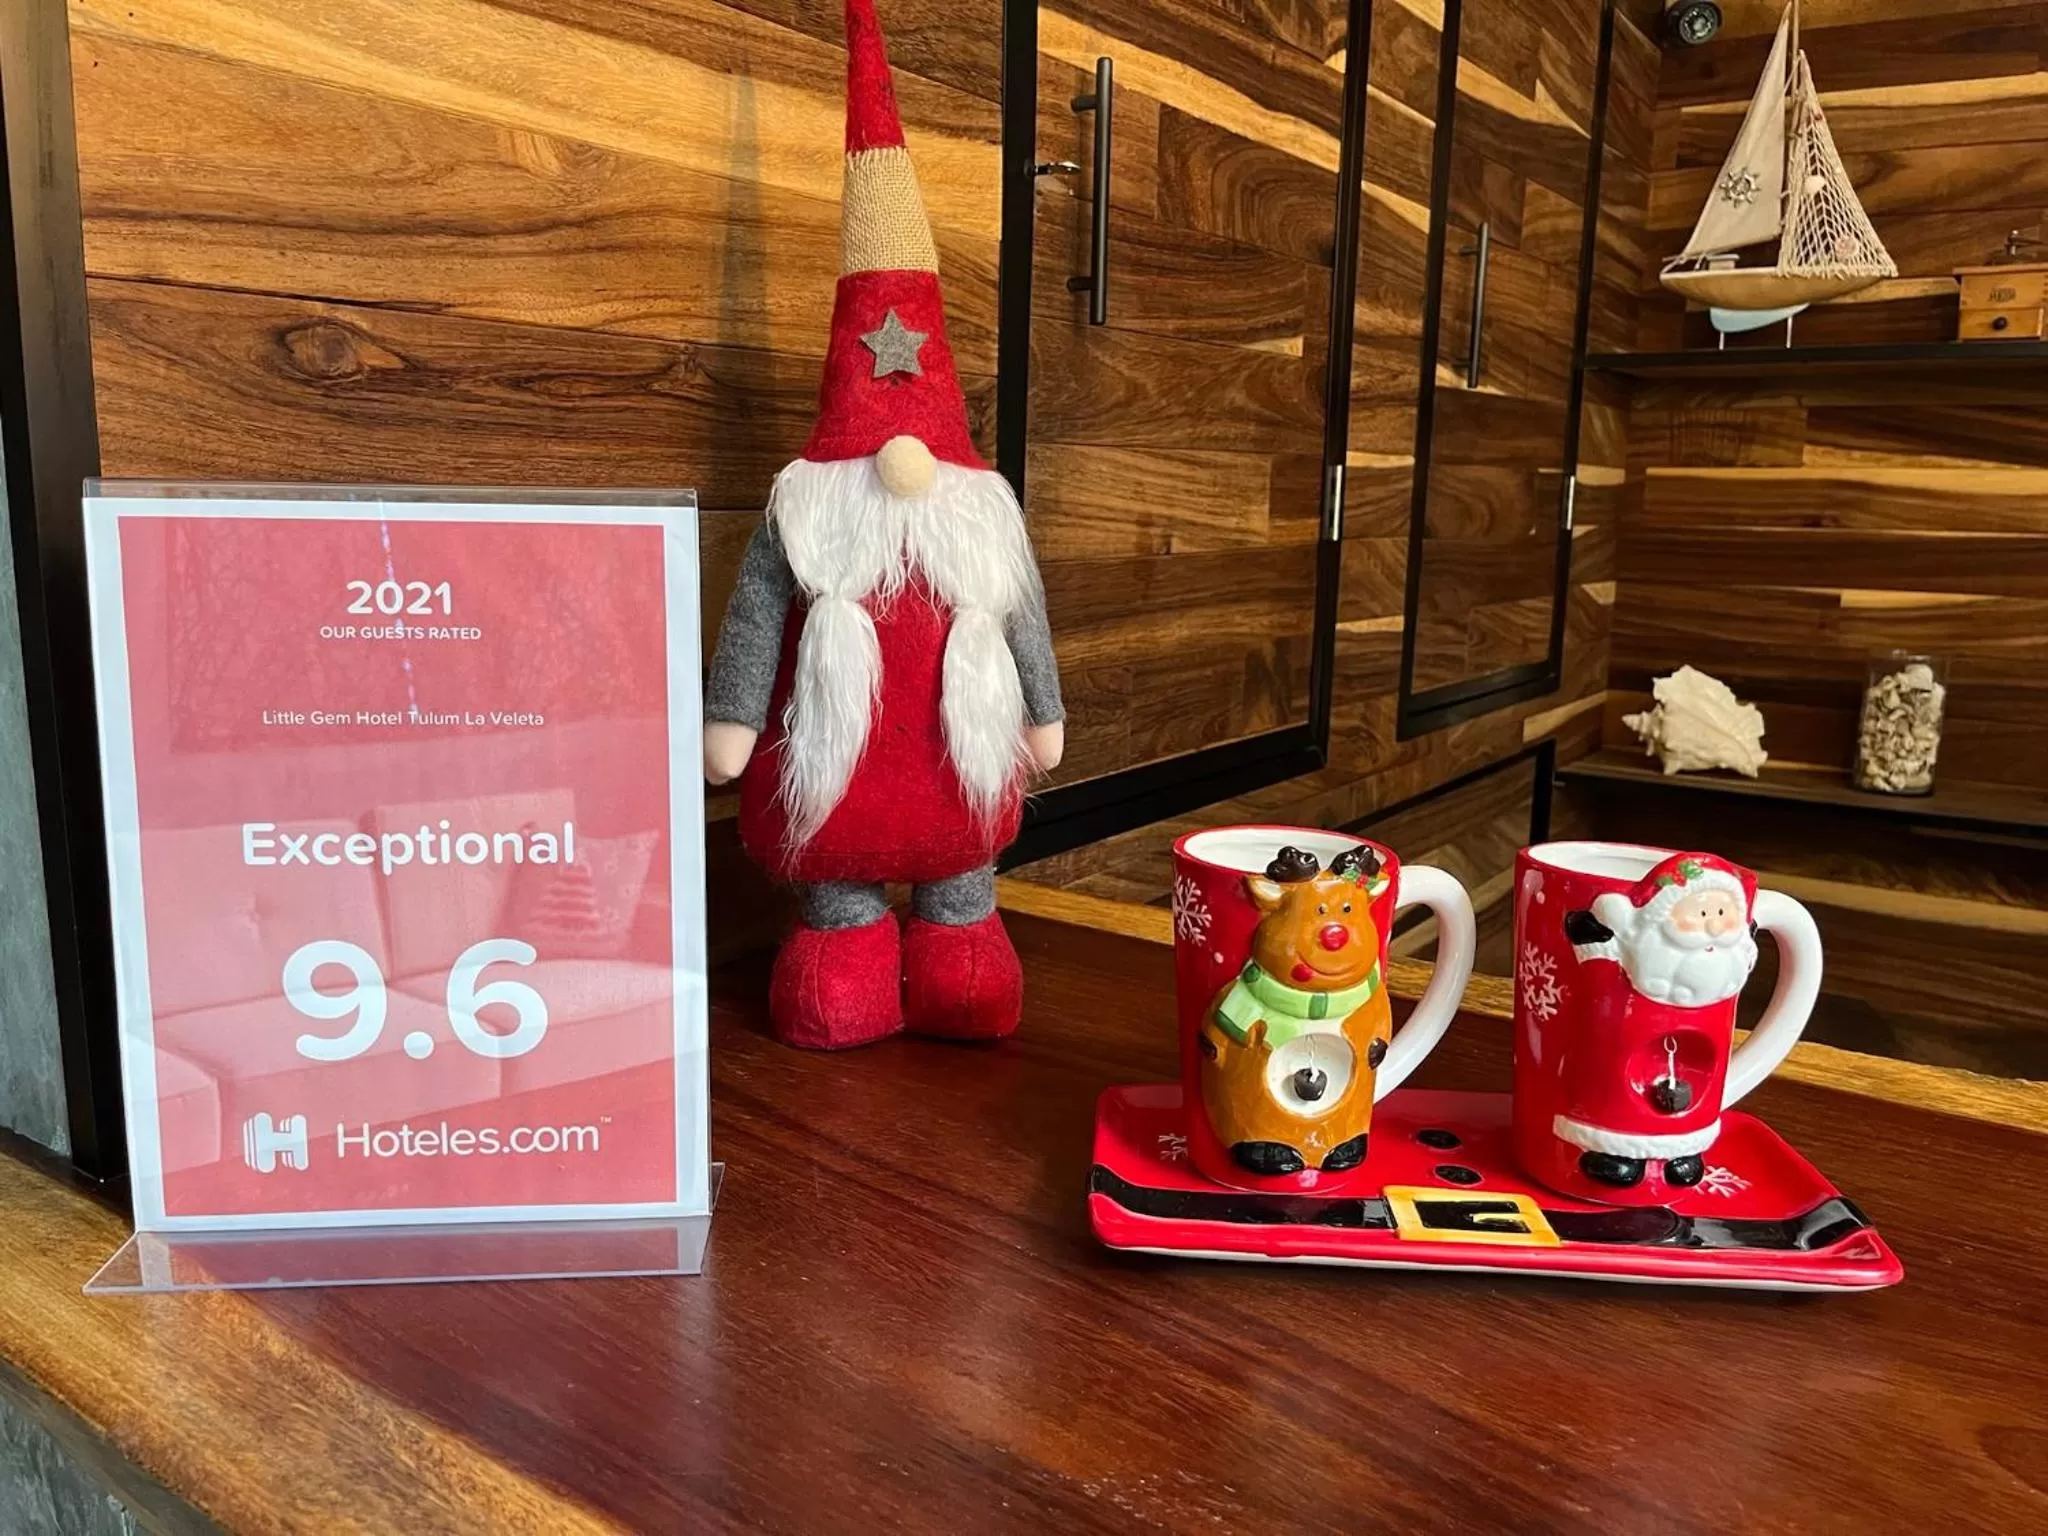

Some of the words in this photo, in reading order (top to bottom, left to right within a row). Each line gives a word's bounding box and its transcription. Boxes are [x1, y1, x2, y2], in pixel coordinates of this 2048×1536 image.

[346, 580, 452, 616] 2021
[319, 625, 356, 640] OUR
[360, 625, 424, 640] GUESTS
[428, 626, 482, 640] RATED
[262, 710, 305, 725] Little
[310, 710, 351, 725] Gem
[356, 711, 402, 725] Hotel
[408, 711, 460, 725] Tulum
[464, 711, 486, 726] La
[490, 711, 544, 726] Veleta
[242, 820, 575, 875] Exceptional
[282, 938, 549, 1062] 9.6
